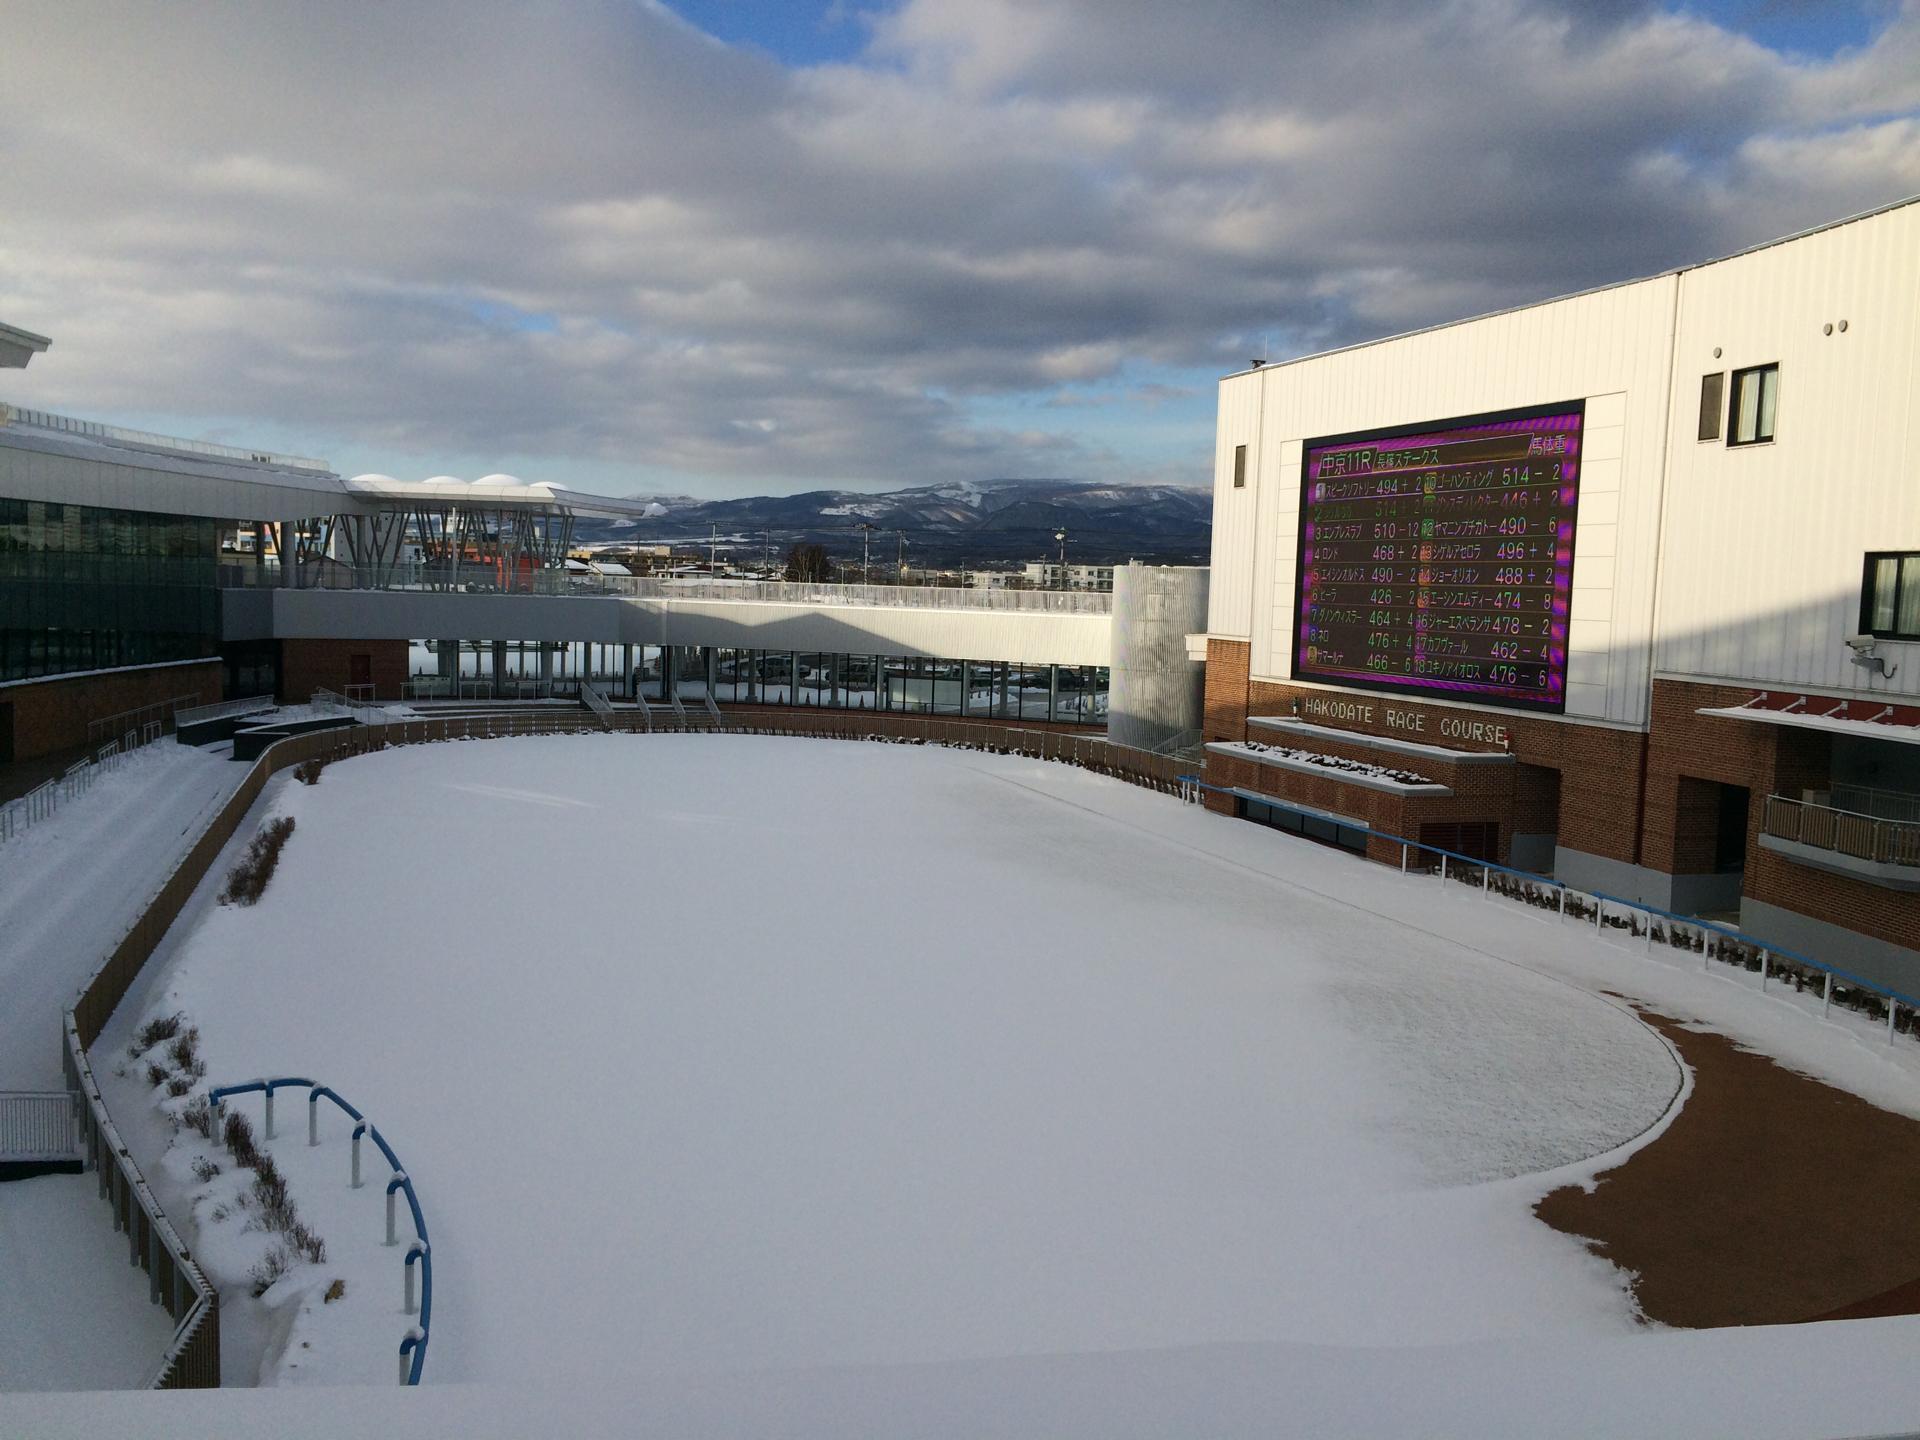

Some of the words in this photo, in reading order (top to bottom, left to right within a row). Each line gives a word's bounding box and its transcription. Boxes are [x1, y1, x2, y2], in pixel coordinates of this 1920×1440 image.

[1531, 434, 1566, 456] 馬体重
[1322, 450, 1371, 476] 中京11R
[1502, 466, 1529, 486] 514
[1377, 479, 1398, 494] 494
[1502, 491, 1528, 509] 446
[1375, 523, 1396, 539] 510
[1498, 517, 1526, 535] 490
[1373, 545, 1394, 560] 468
[1433, 544, 1481, 560] シゲルアセロラ
[1496, 542, 1524, 560] 496
[1372, 568, 1393, 582] 490
[1431, 567, 1480, 583] ジョーオリオン
[1495, 567, 1523, 585] 488
[1370, 589, 1392, 604] 426
[1430, 591, 1493, 608] エーシンエムディー
[1494, 592, 1520, 609] 474
[1369, 609, 1391, 626] 464
[1492, 616, 1520, 635] 478
[1368, 632, 1389, 648] 476
[1490, 641, 1517, 659] 462
[1367, 653, 1388, 670] 466
[1489, 664, 1516, 684] 476
[1305, 698, 1374, 723] HAKODATE
[1386, 710, 1425, 732] RACE
[1440, 718, 1506, 745] COURSE
